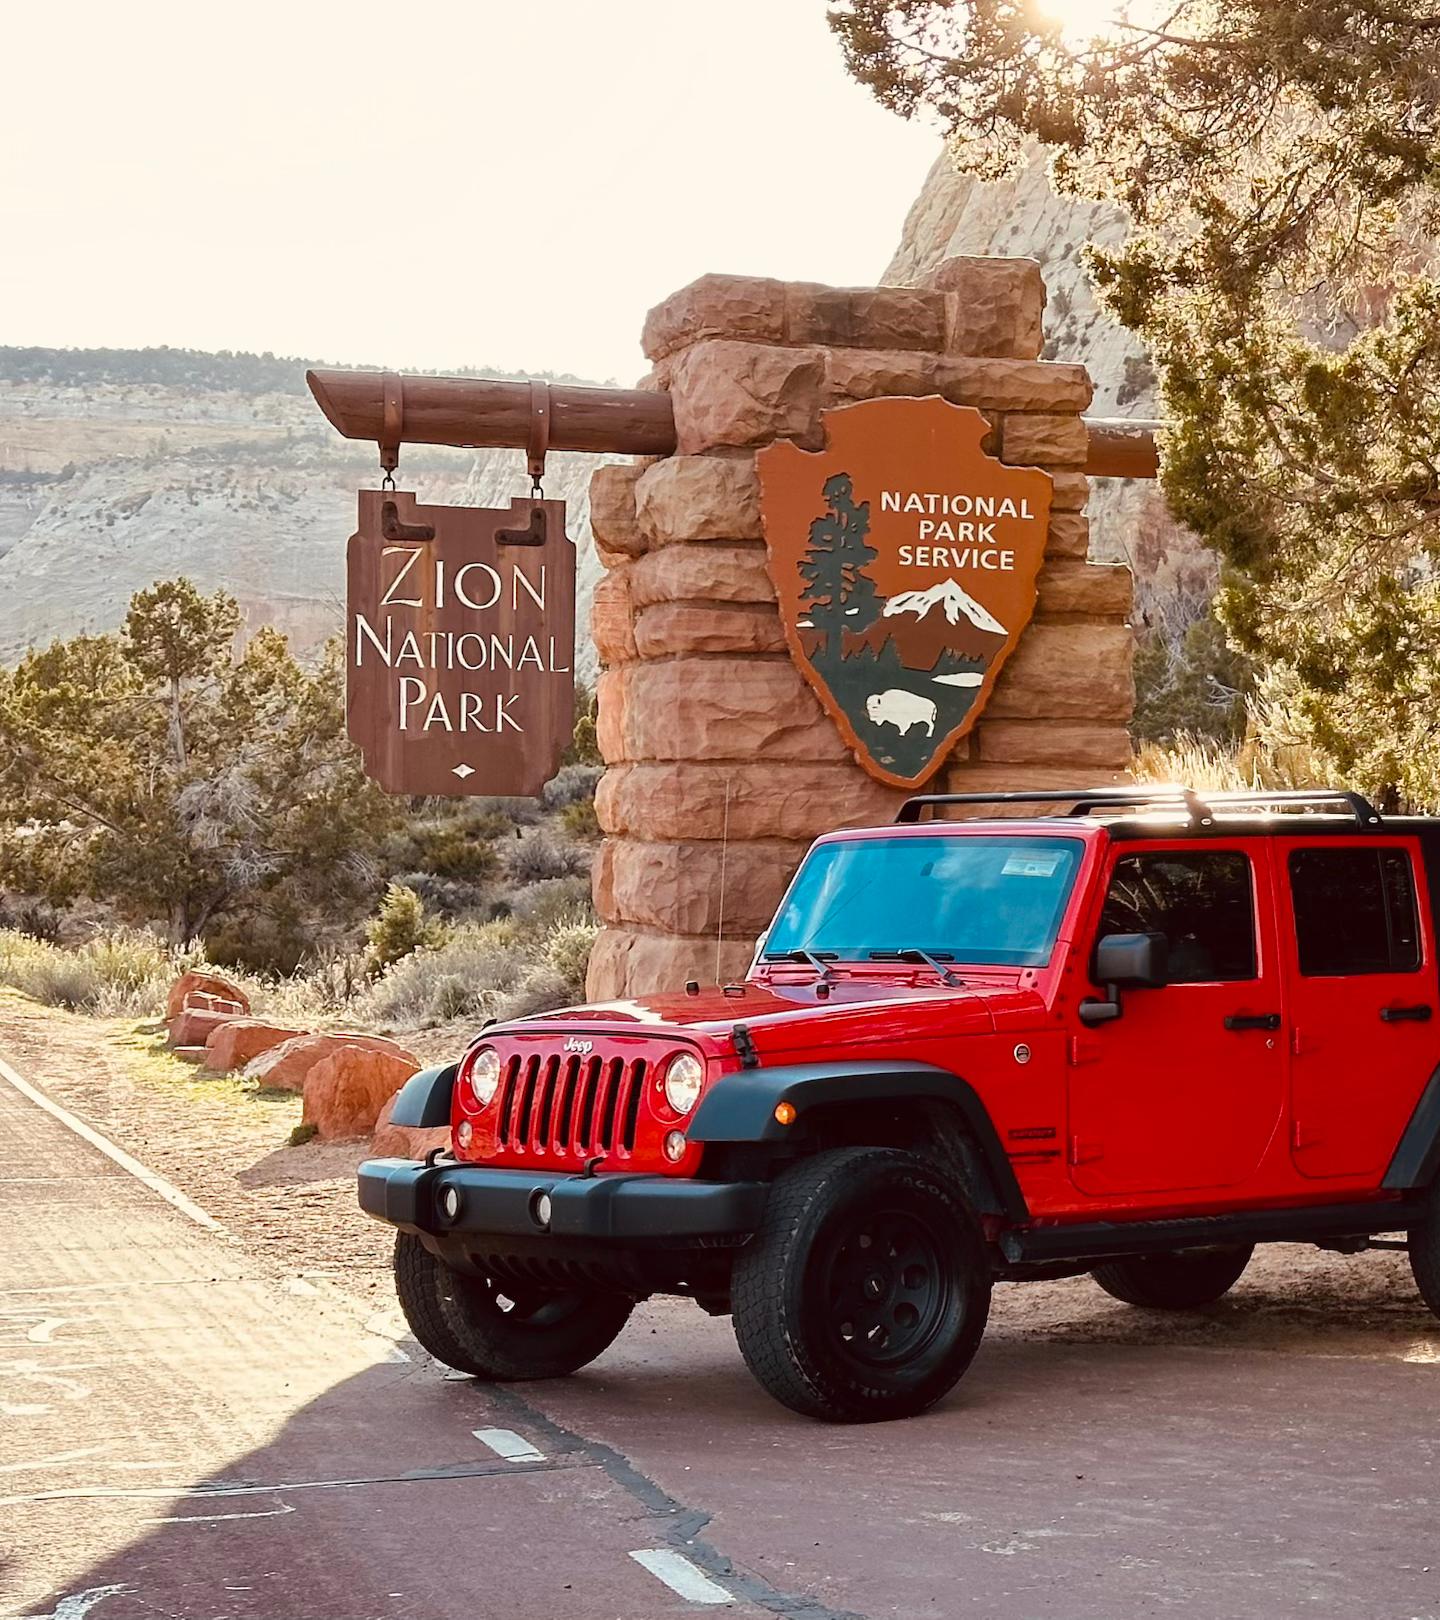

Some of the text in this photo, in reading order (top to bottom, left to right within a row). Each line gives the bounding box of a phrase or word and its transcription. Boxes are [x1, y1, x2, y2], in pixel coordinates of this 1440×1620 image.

[880, 491, 1034, 520] NATIONAL
[919, 519, 997, 544] PARK
[898, 545, 1014, 571] SERVICE
[380, 546, 546, 611] ZION
[356, 613, 570, 673] NATIONAL
[399, 676, 525, 733] PARK
[563, 1037, 593, 1055] Jeep
